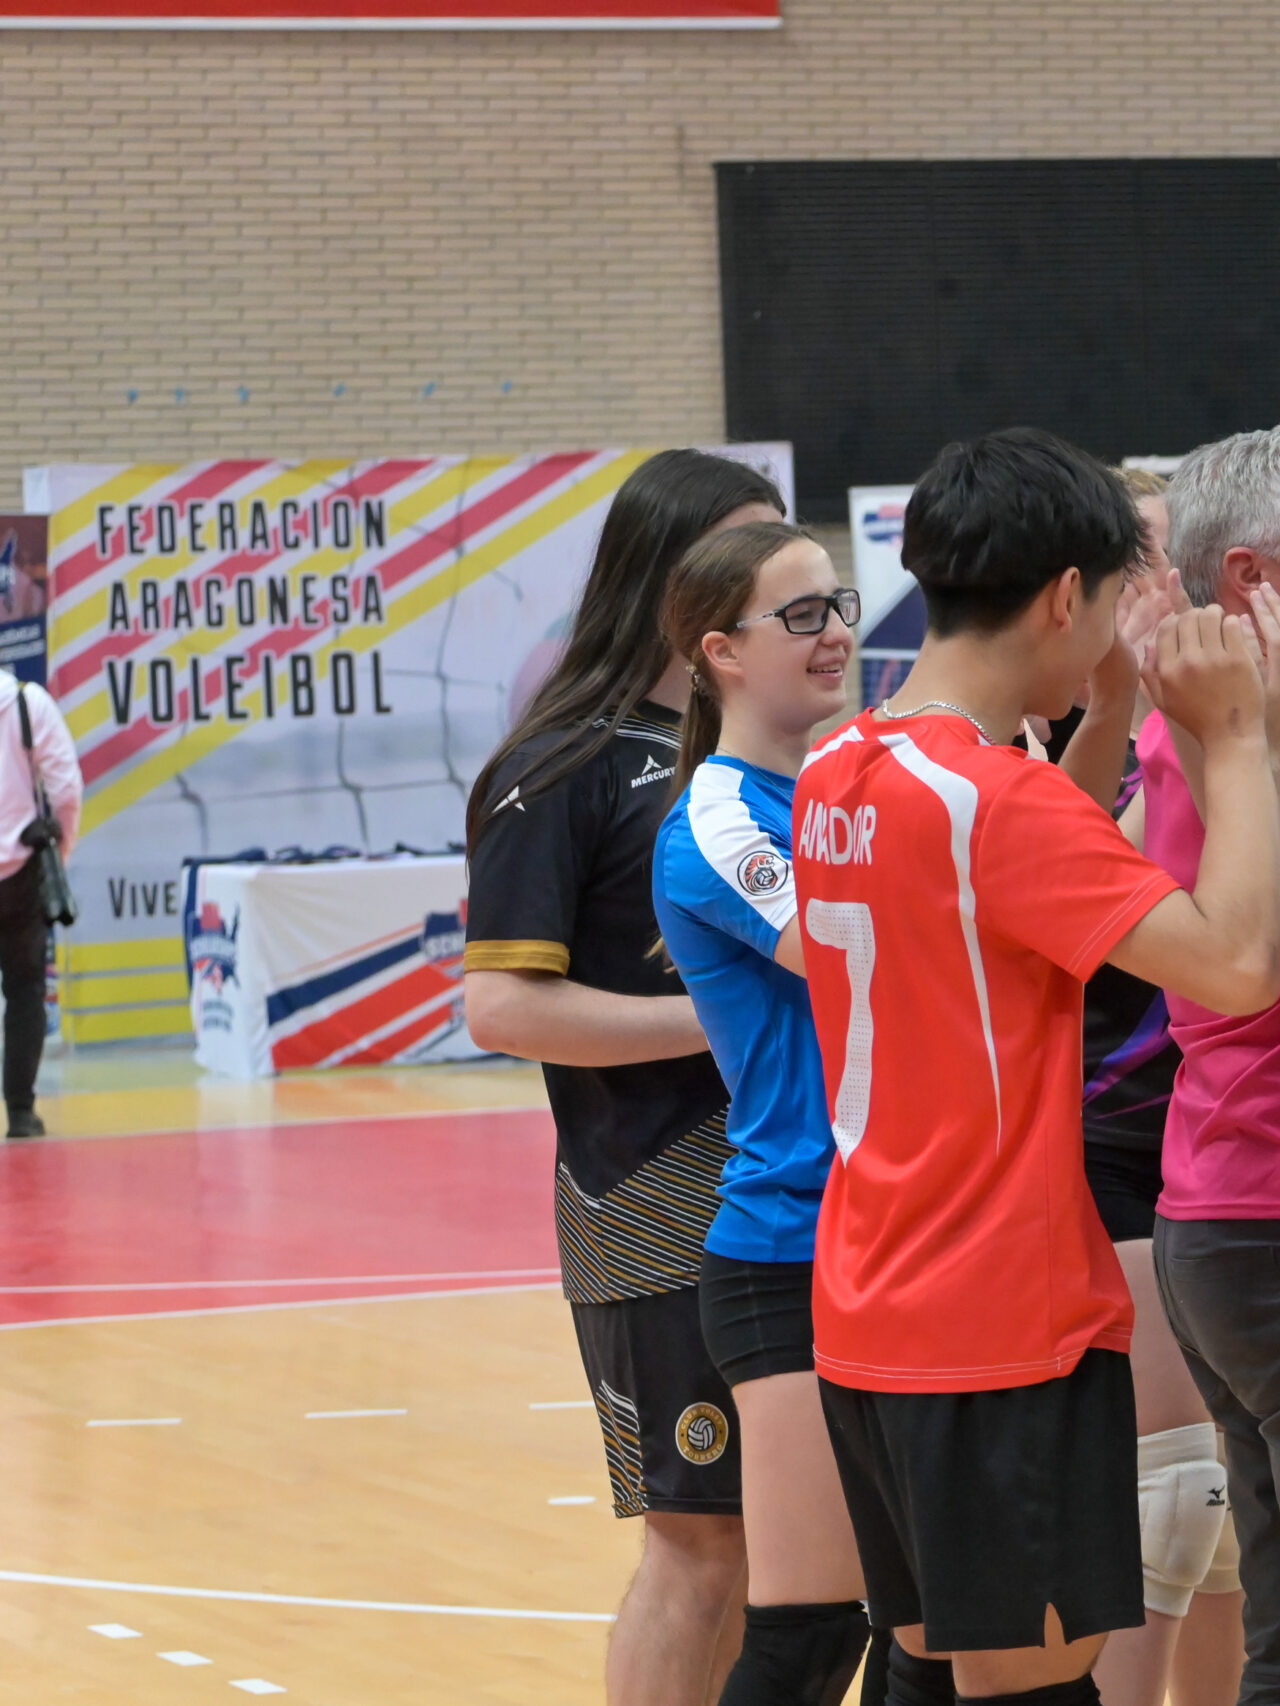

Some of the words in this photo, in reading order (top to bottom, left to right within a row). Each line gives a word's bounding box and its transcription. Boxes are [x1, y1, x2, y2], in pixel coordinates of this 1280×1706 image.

[98, 500, 386, 555] FEDERACION
[110, 574, 384, 631] ARAGONESA
[107, 651, 392, 725] VOLEIBOL
[631, 766, 676, 788] MERCURY
[806, 898, 876, 1168] 7
